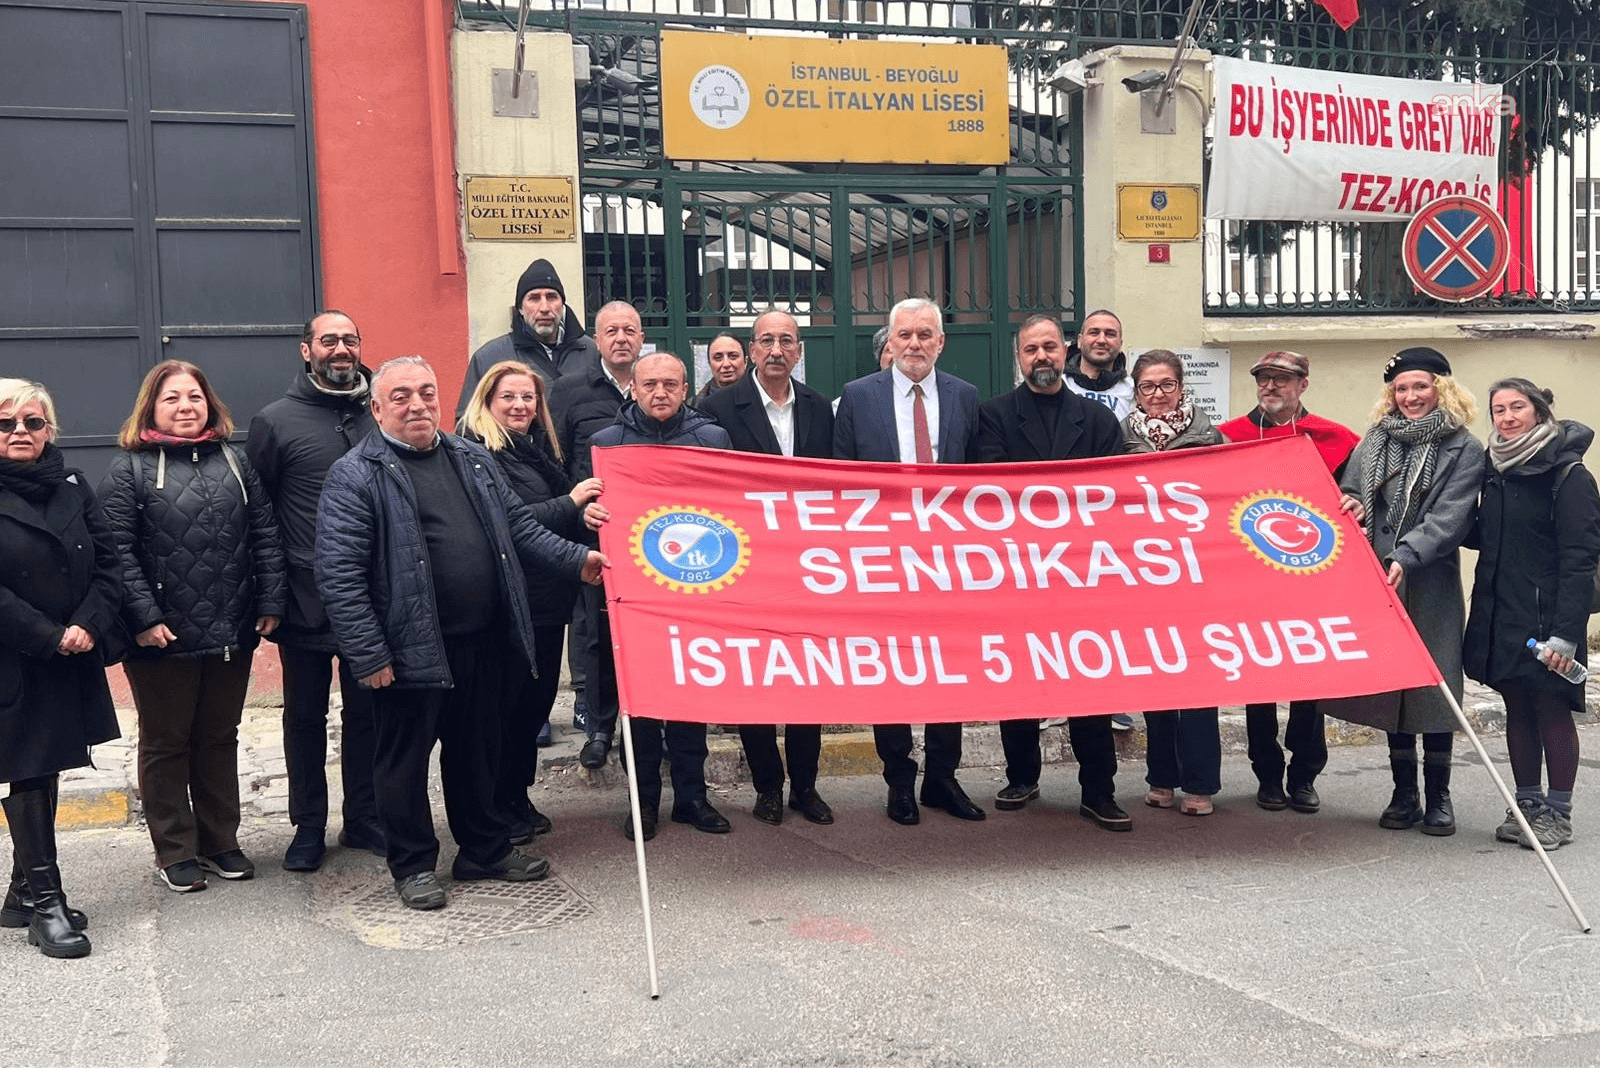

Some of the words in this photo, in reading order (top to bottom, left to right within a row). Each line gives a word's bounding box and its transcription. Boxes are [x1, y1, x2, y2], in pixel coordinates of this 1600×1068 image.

[790, 61, 872, 83] İSTANBUL
[885, 65, 960, 84] BEYOĞLU
[764, 84, 821, 110] ÖZEL
[828, 85, 916, 112] İTALYAN
[921, 87, 985, 113] LİSESİ
[1228, 83, 1264, 138] BU
[1269, 76, 1393, 154] İŞYERİNDE
[1398, 100, 1453, 154] GREV
[1459, 105, 1496, 157] VAR.
[947, 119, 985, 132] 1888
[509, 183, 531, 193] T.C.
[471, 193, 495, 203] MİLLİ
[496, 193, 525, 203] EĞİTİM
[527, 193, 569, 204] BAKANLIĞI
[471, 205, 508, 219] ÖZEL
[511, 205, 570, 219] İTALYAN
[502, 221, 543, 235] LİSESİ
[1156, 247, 1164, 259] 3
[1186, 361, 1220, 369] YAKININDA
[743, 475, 1211, 533] TEZ-KOOP-İŞ
[1242, 503, 1312, 522] TÜRK-İŞ
[648, 517, 673, 533] TEZ
[686, 549, 709, 567] tk
[799, 536, 1204, 595] SENDİKASI
[1279, 552, 1323, 566] 1952
[679, 570, 713, 582] 1962
[667, 625, 968, 688] İSTANBUL
[981, 634, 1013, 684] 5
[1026, 626, 1189, 681] NOLU
[1202, 616, 1369, 682] ŞUBE
